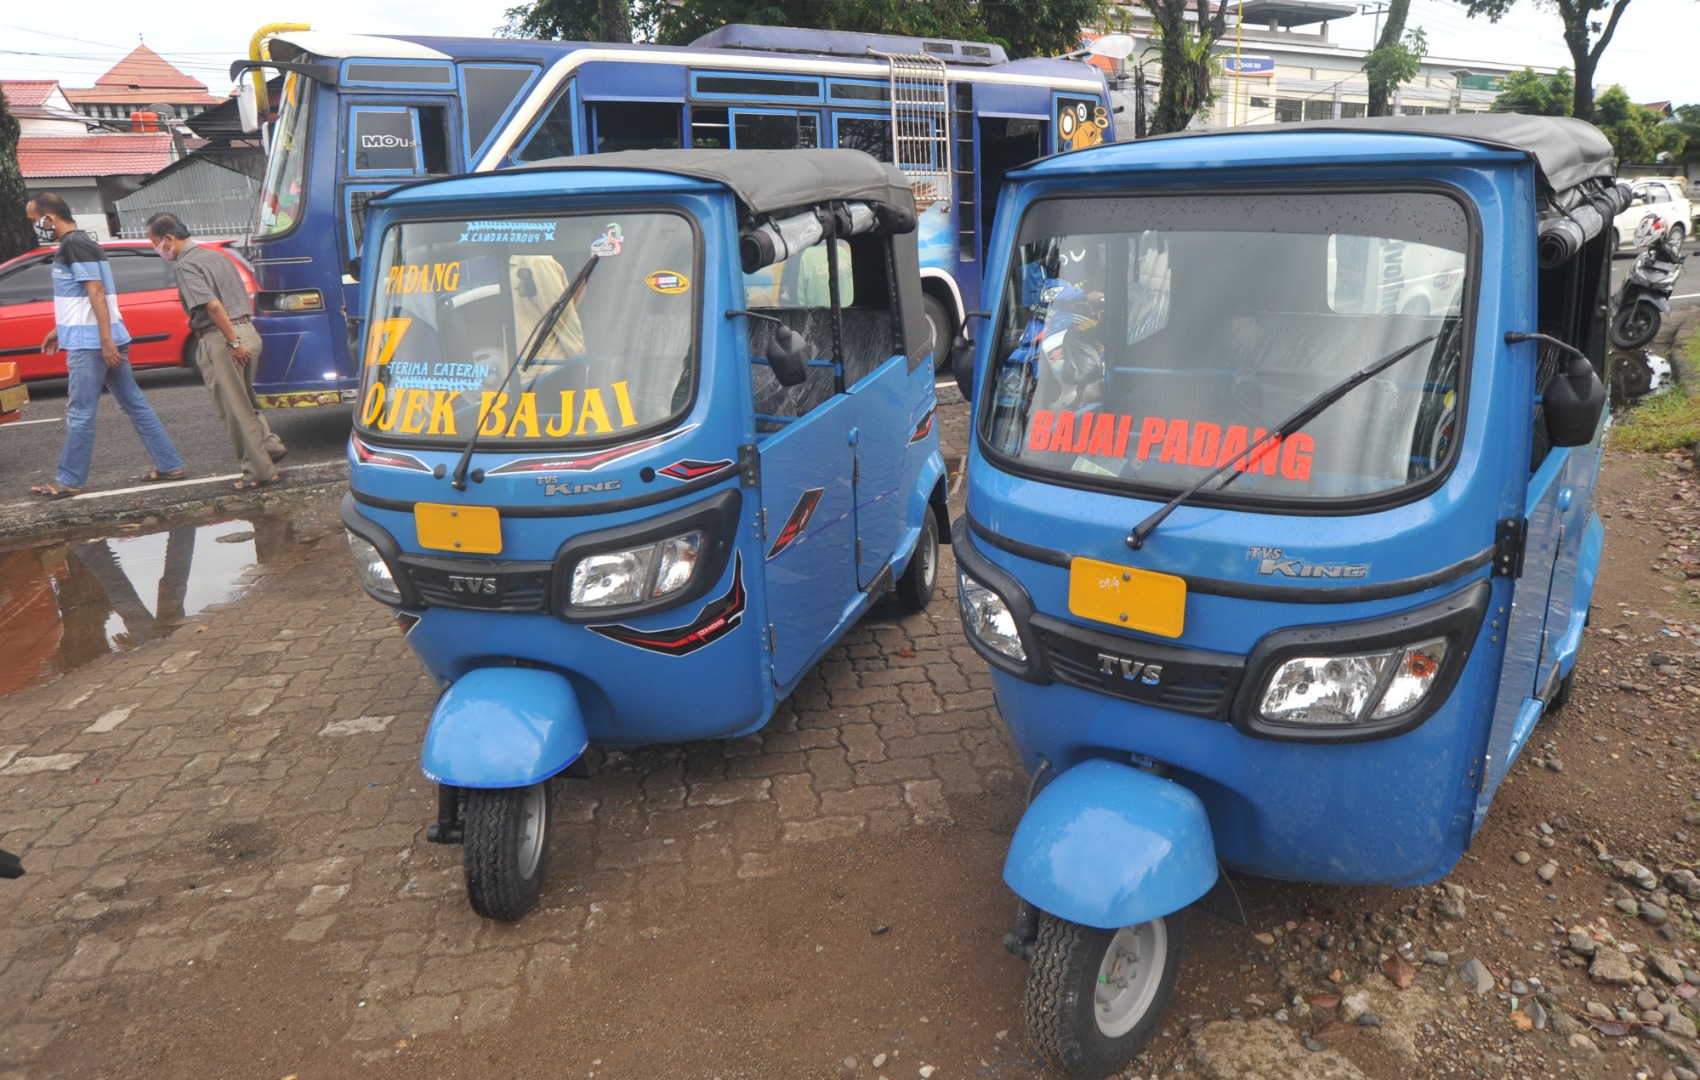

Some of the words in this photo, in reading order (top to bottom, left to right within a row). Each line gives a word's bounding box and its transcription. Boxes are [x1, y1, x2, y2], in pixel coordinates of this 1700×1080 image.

[385, 261, 461, 295] PADANG
[388, 361, 429, 376] TERIMA
[432, 362, 490, 378] CATERAN
[361, 381, 465, 435] OJEK
[477, 380, 639, 438] BAJAI
[1027, 409, 1133, 458] BAJAI
[1136, 416, 1316, 482] PADANG
[536, 475, 559, 485] TVS
[1249, 546, 1283, 560] TVS
[448, 575, 497, 595] TVS
[1096, 653, 1163, 686] TVS
